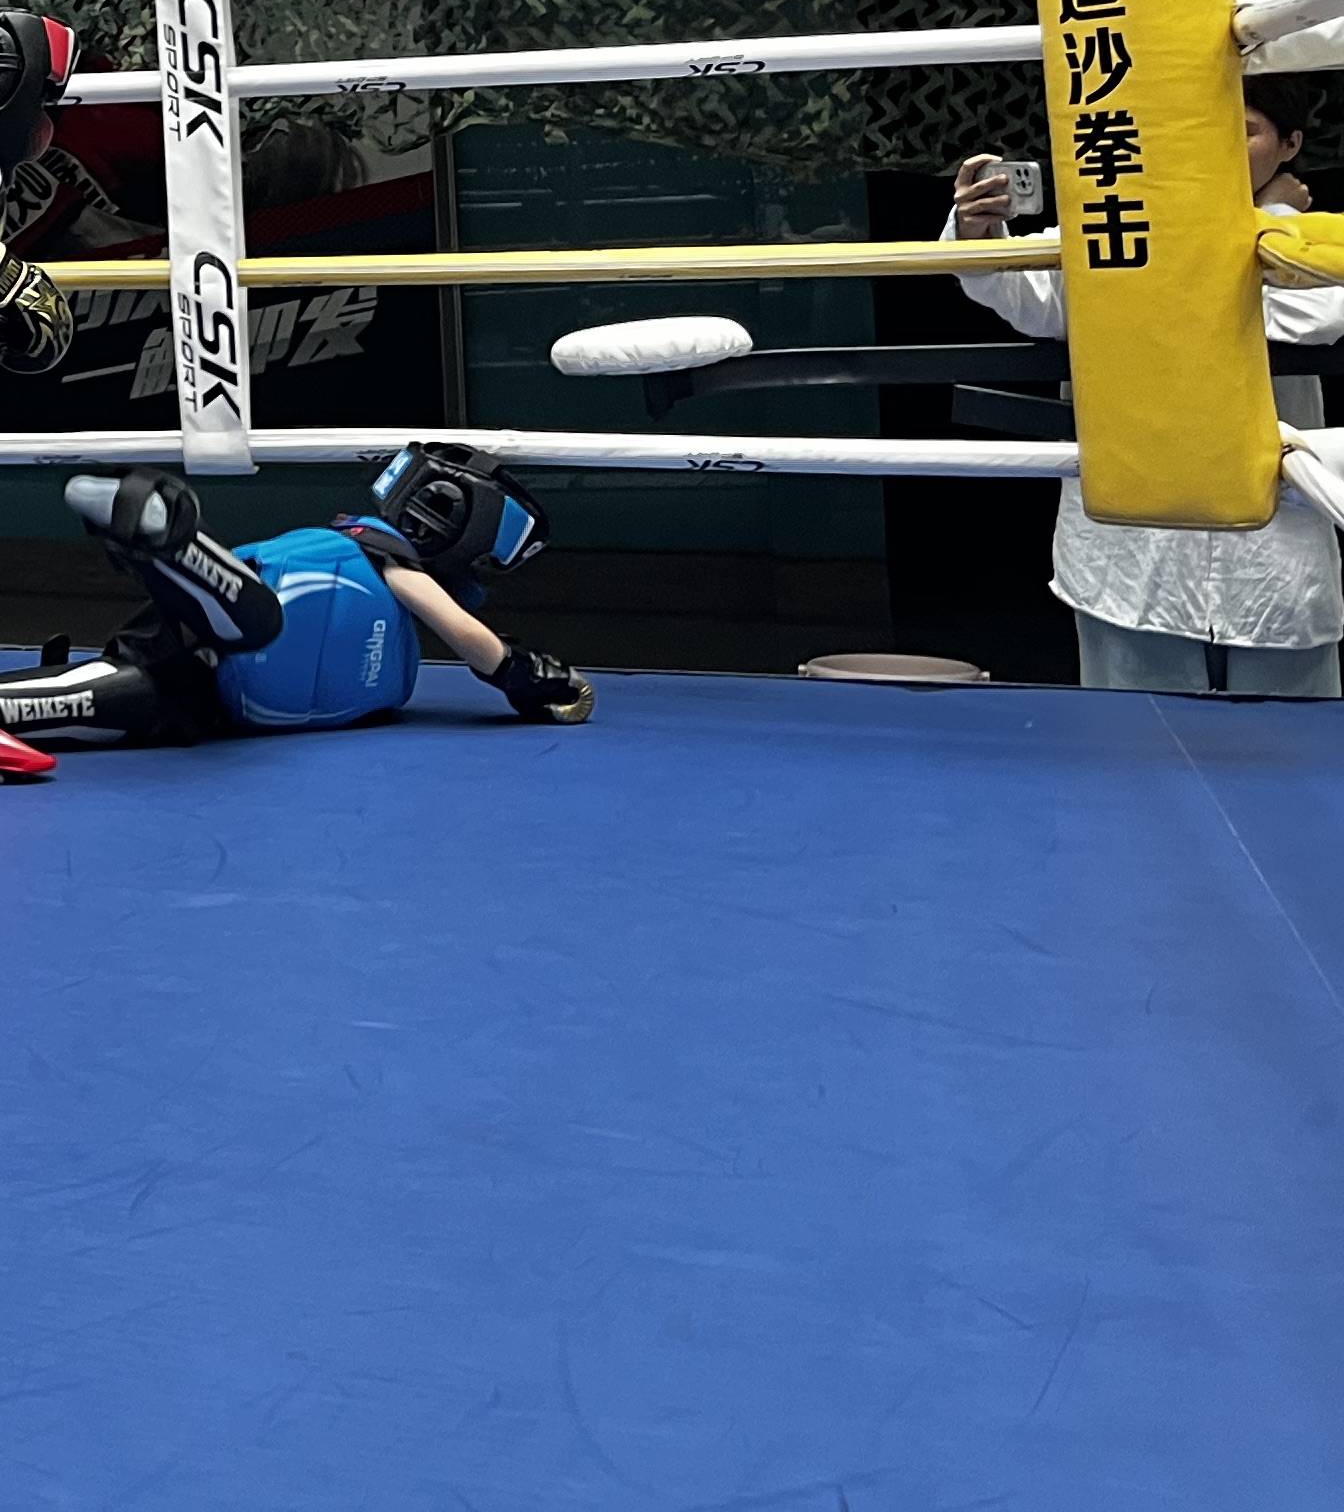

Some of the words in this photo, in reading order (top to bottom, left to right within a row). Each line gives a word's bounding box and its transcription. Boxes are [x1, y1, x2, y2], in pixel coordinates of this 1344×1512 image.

[163, 23, 182, 143] SPORT
[177, 292, 199, 413] SPORT
[193, 251, 242, 423] CSK
[175, 540, 244, 604] EIKETE
